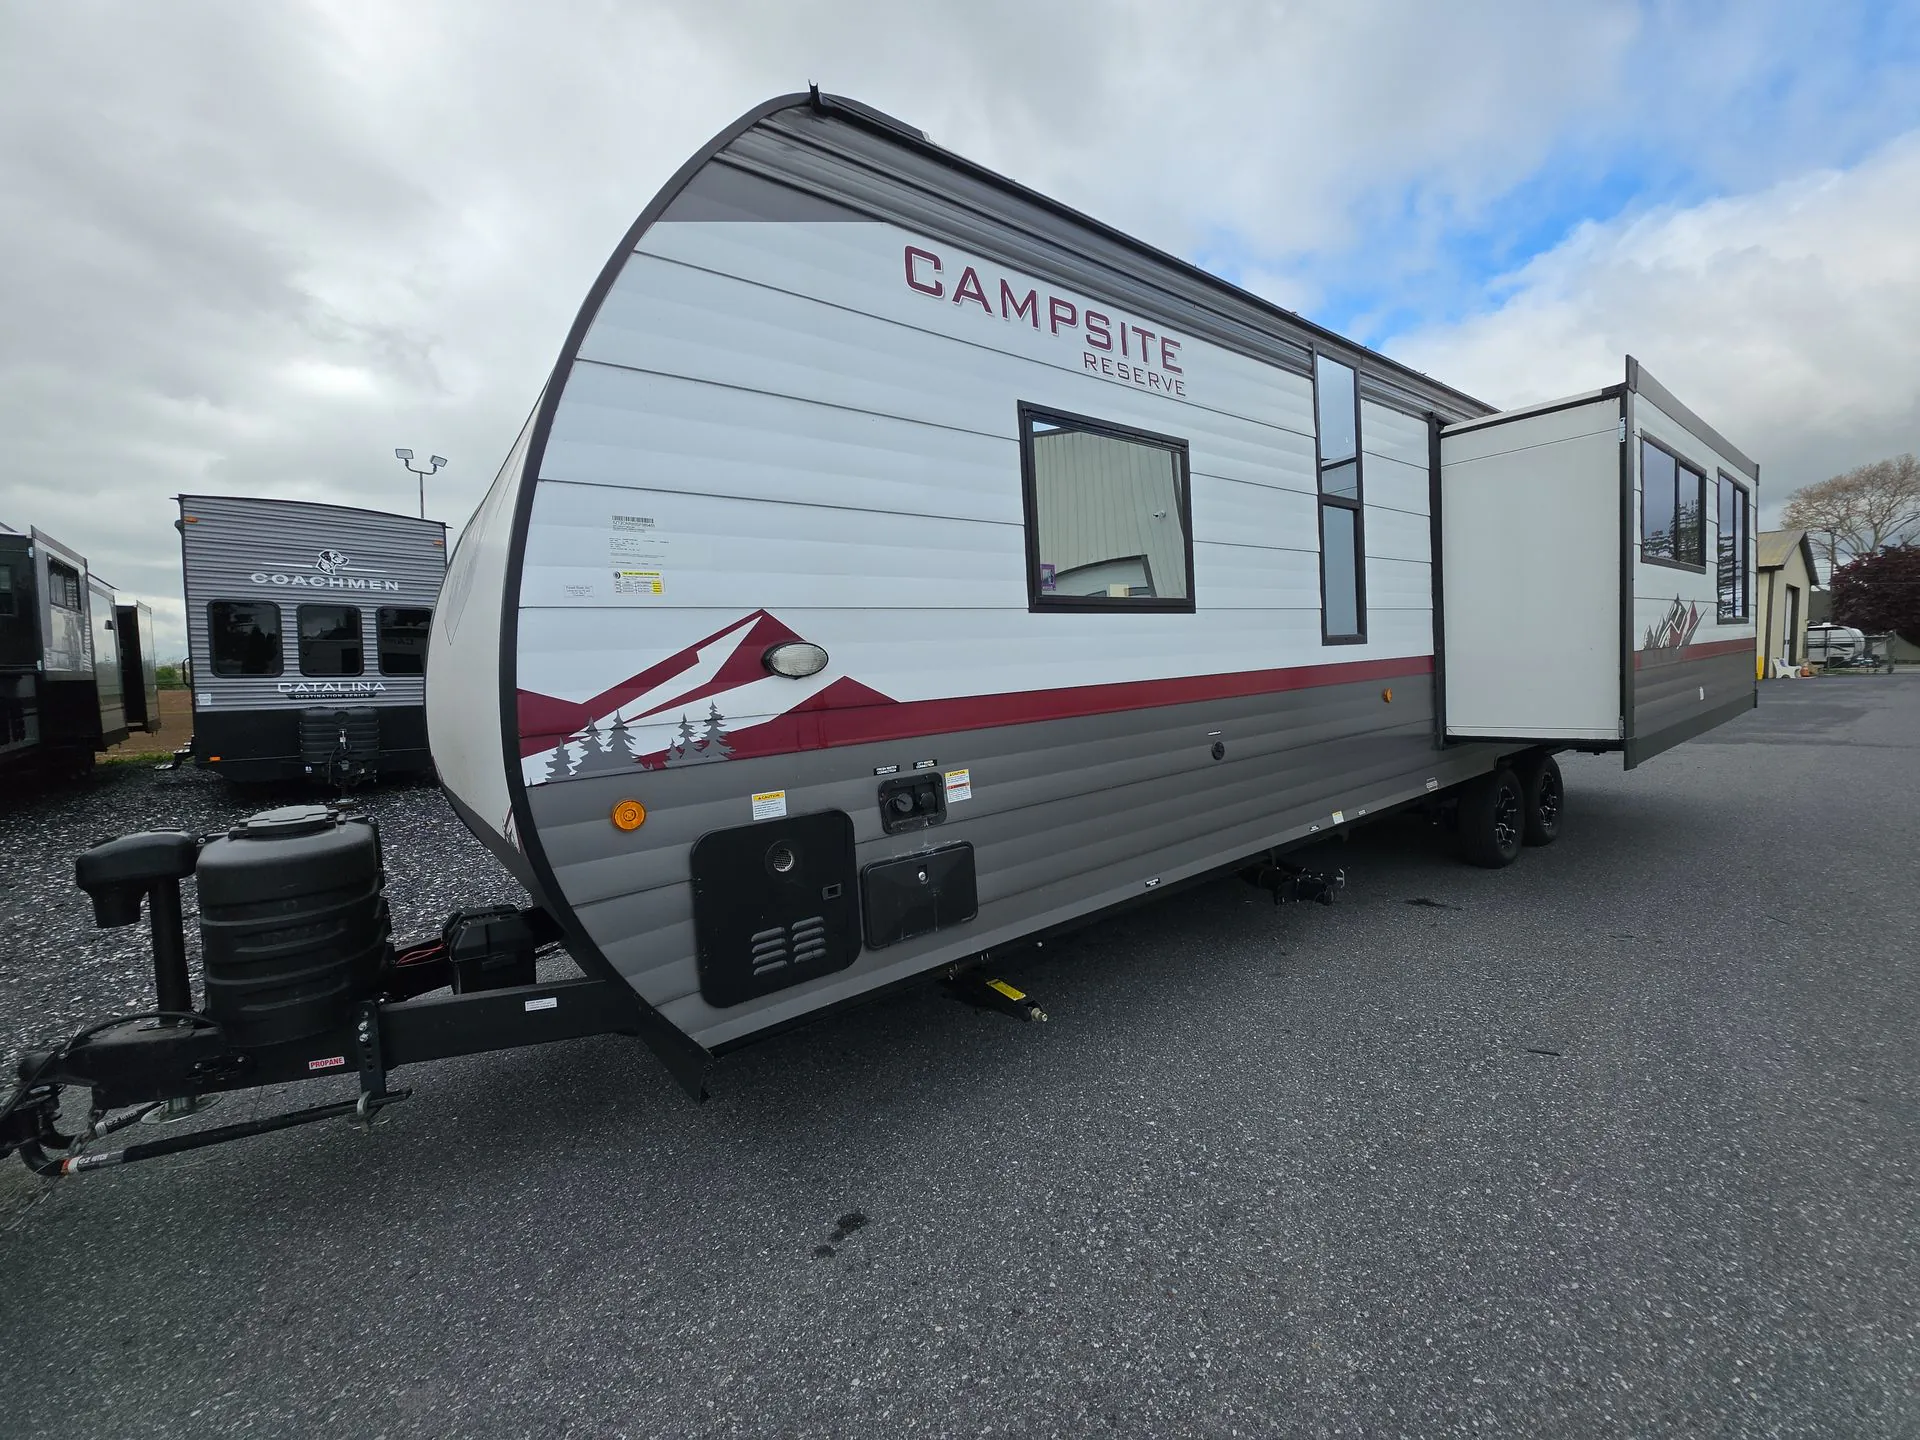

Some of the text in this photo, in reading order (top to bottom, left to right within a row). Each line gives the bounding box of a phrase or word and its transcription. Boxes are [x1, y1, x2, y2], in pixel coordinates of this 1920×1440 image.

[904, 245, 1184, 374] CAMPSITE
[1083, 351, 1186, 397] RESERVE
[250, 572, 399, 591] COACHMEN
[277, 681, 387, 693] CATALINA
[310, 1057, 344, 1068] PROPANE
